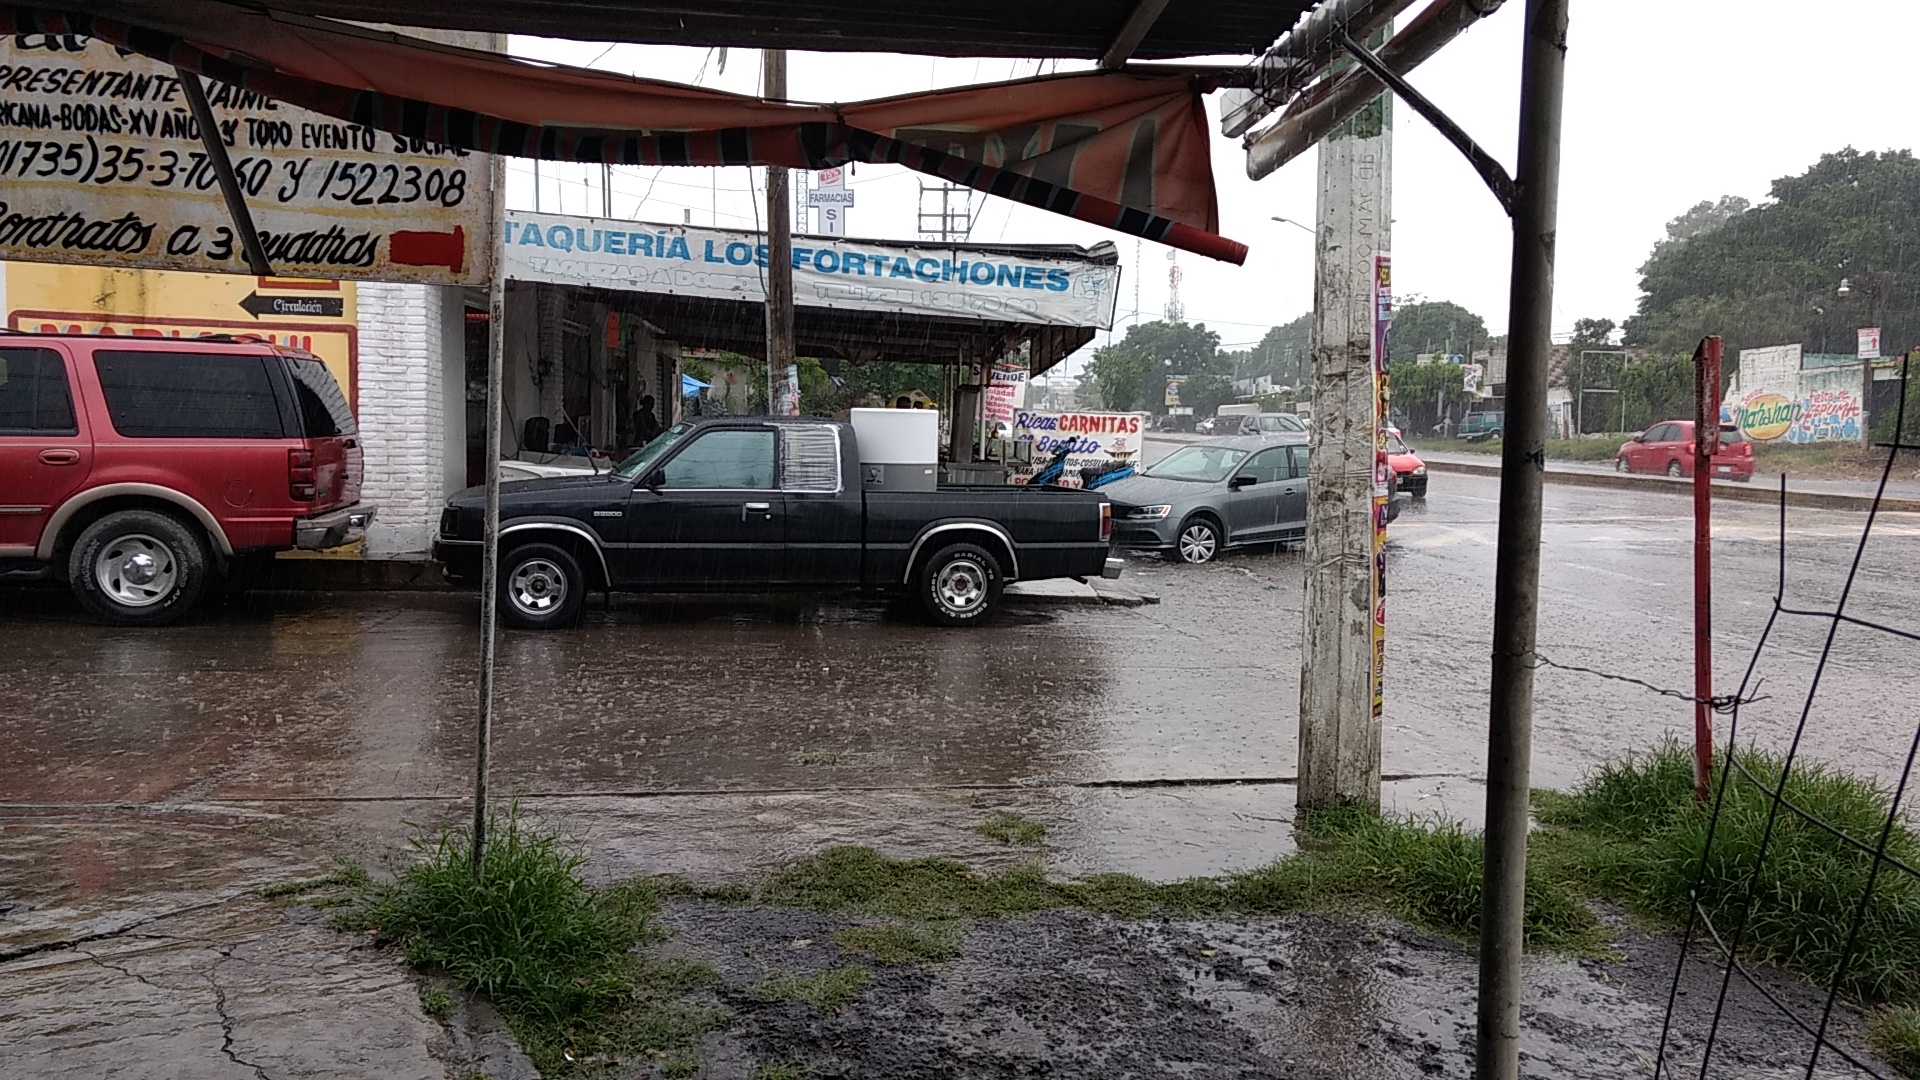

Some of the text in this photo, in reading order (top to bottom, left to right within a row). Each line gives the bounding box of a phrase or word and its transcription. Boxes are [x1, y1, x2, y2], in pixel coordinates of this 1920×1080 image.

[246, 118, 292, 150] TODO
[302, 122, 376, 152] EVENTO
[317, 160, 467, 207] 1522308
[810, 193, 853, 203] FARMACIAS
[167, 225, 202, 256] a
[206, 226, 234, 261] 3
[504, 219, 692, 261] TAQUERÍA
[704, 239, 770, 269] LOS
[791, 246, 1070, 293] FORTACHONES
[273, 299, 323, 314] Circulación
[1015, 412, 1058, 430] Ricas
[1060, 415, 1140, 434] CARNITAS
[1803, 398, 1860, 429] ESPUMA
